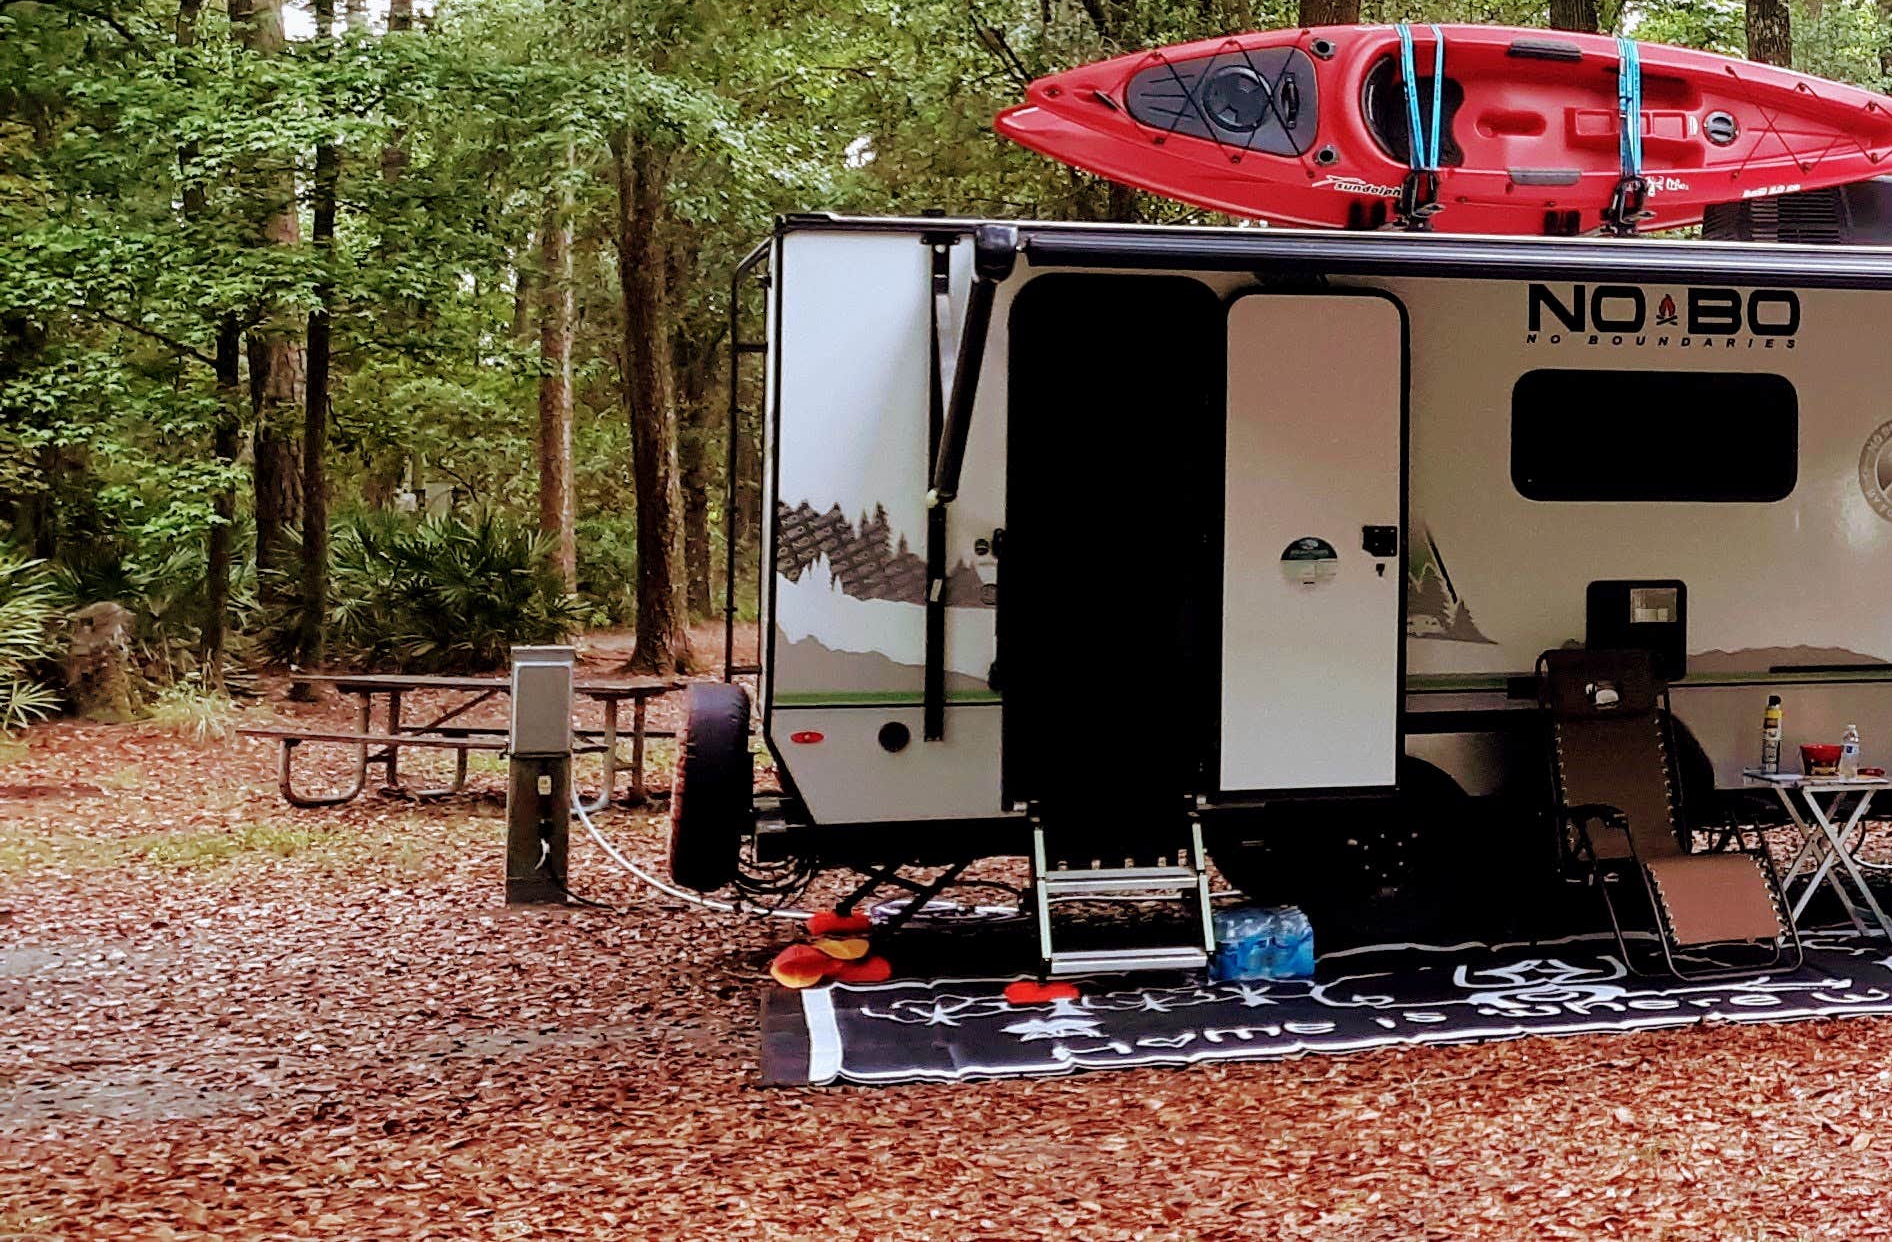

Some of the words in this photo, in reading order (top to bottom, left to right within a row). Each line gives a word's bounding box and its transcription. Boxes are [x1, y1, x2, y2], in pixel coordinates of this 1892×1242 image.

[1335, 182, 1401, 197] sundolph
[1526, 334, 1561, 345] NO
[1588, 335, 1799, 350] BOUNDARIES
[1052, 1022, 1336, 1061] Home
[1370, 1012, 1447, 1029] is
[1477, 994, 1783, 1018] where
